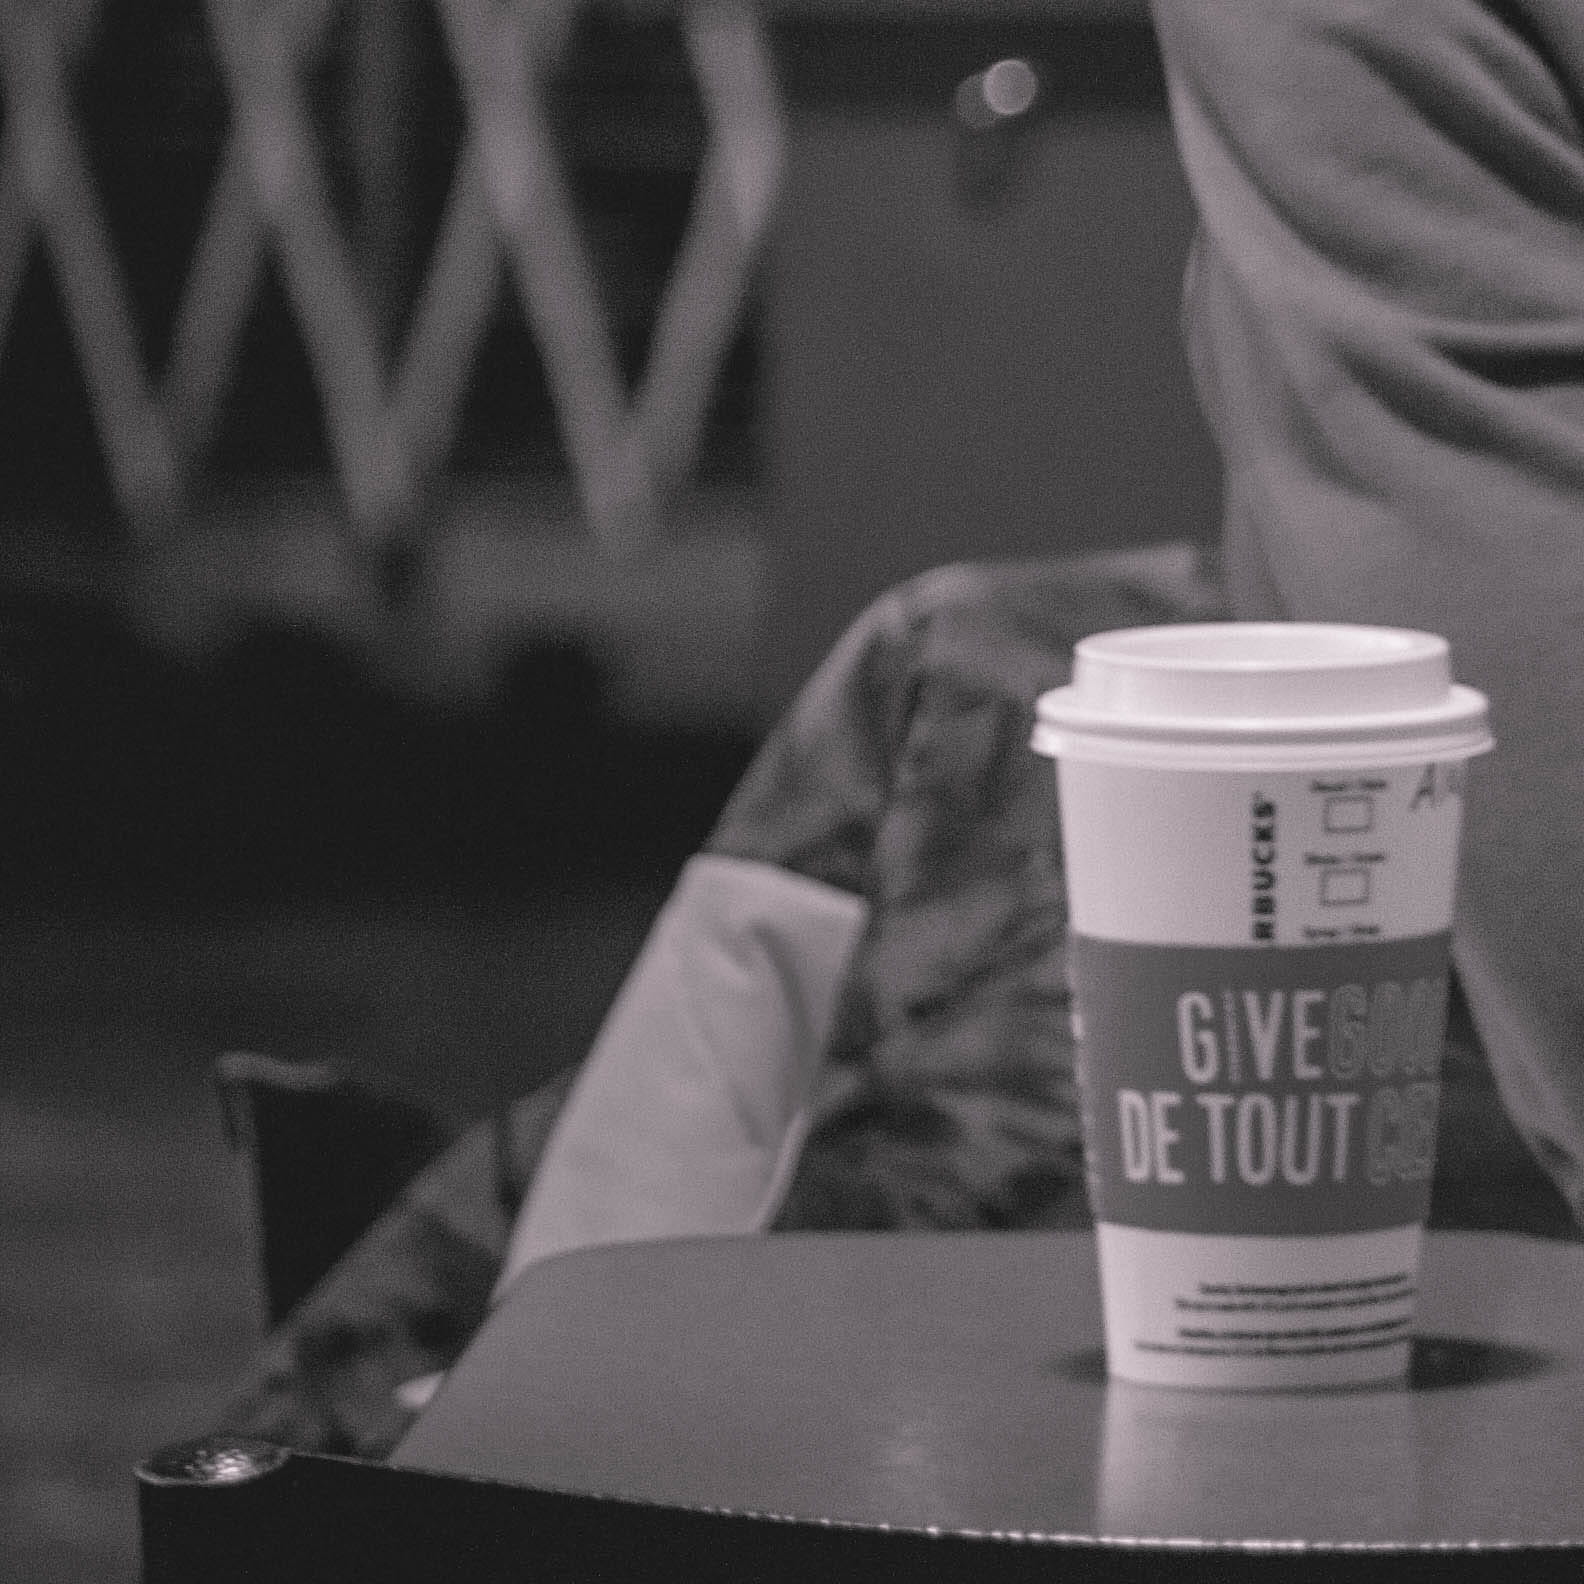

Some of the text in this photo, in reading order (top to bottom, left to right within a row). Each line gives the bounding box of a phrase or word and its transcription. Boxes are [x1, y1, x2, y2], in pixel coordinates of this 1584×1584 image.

[1176, 989, 1328, 1083] GIVE
[1117, 1089, 1185, 1185] DE
[1196, 1091, 1361, 1185] TOUT
